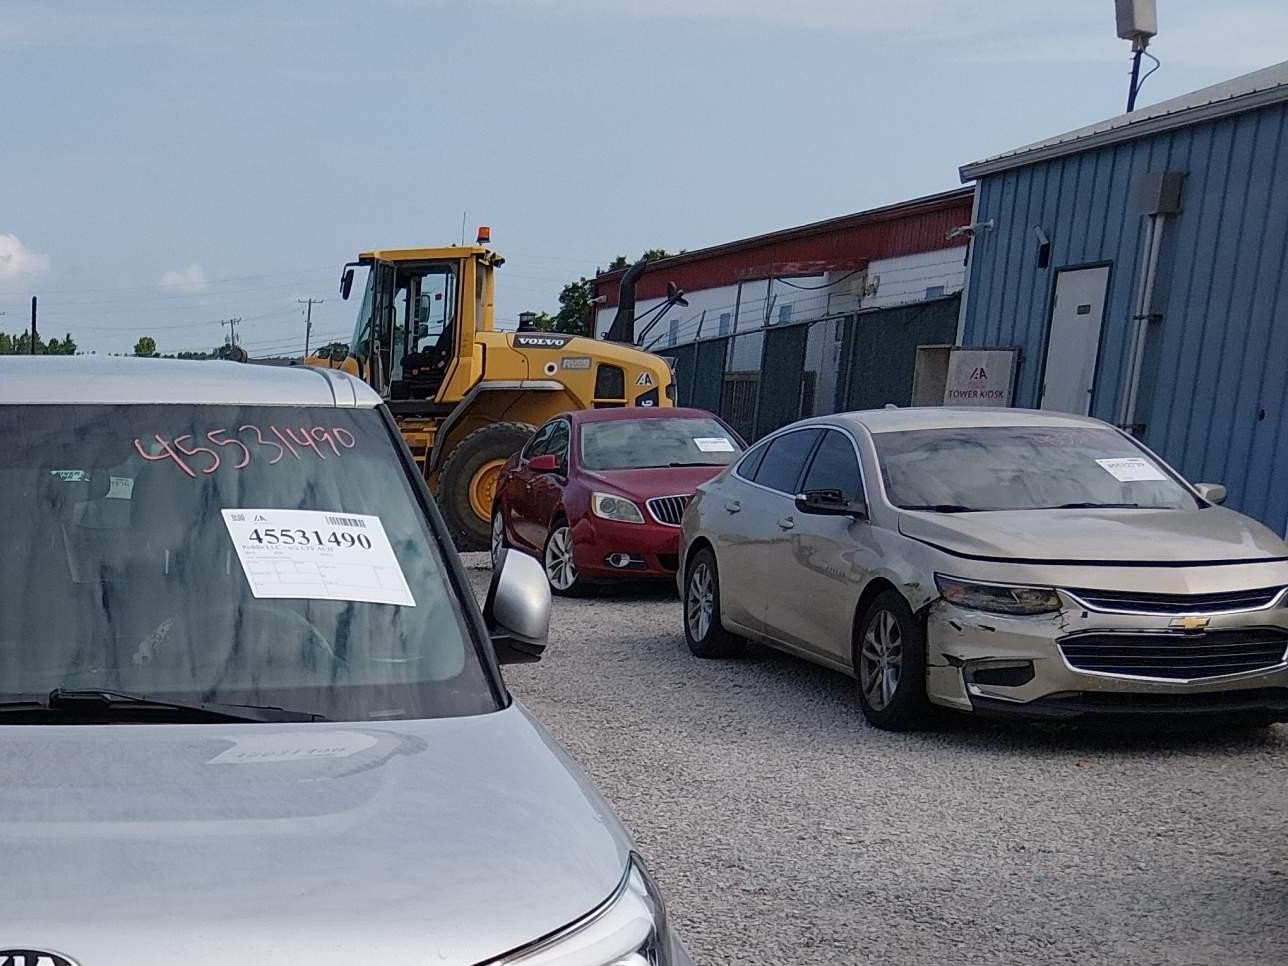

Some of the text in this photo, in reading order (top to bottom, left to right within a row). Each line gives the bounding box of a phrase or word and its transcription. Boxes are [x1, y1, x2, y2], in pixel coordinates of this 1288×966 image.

[518, 337, 564, 346] VOLVO
[949, 390, 1004, 399] TOWER KIOSK
[134, 424, 356, 478] 45531490
[249, 528, 372, 550] 45531490
